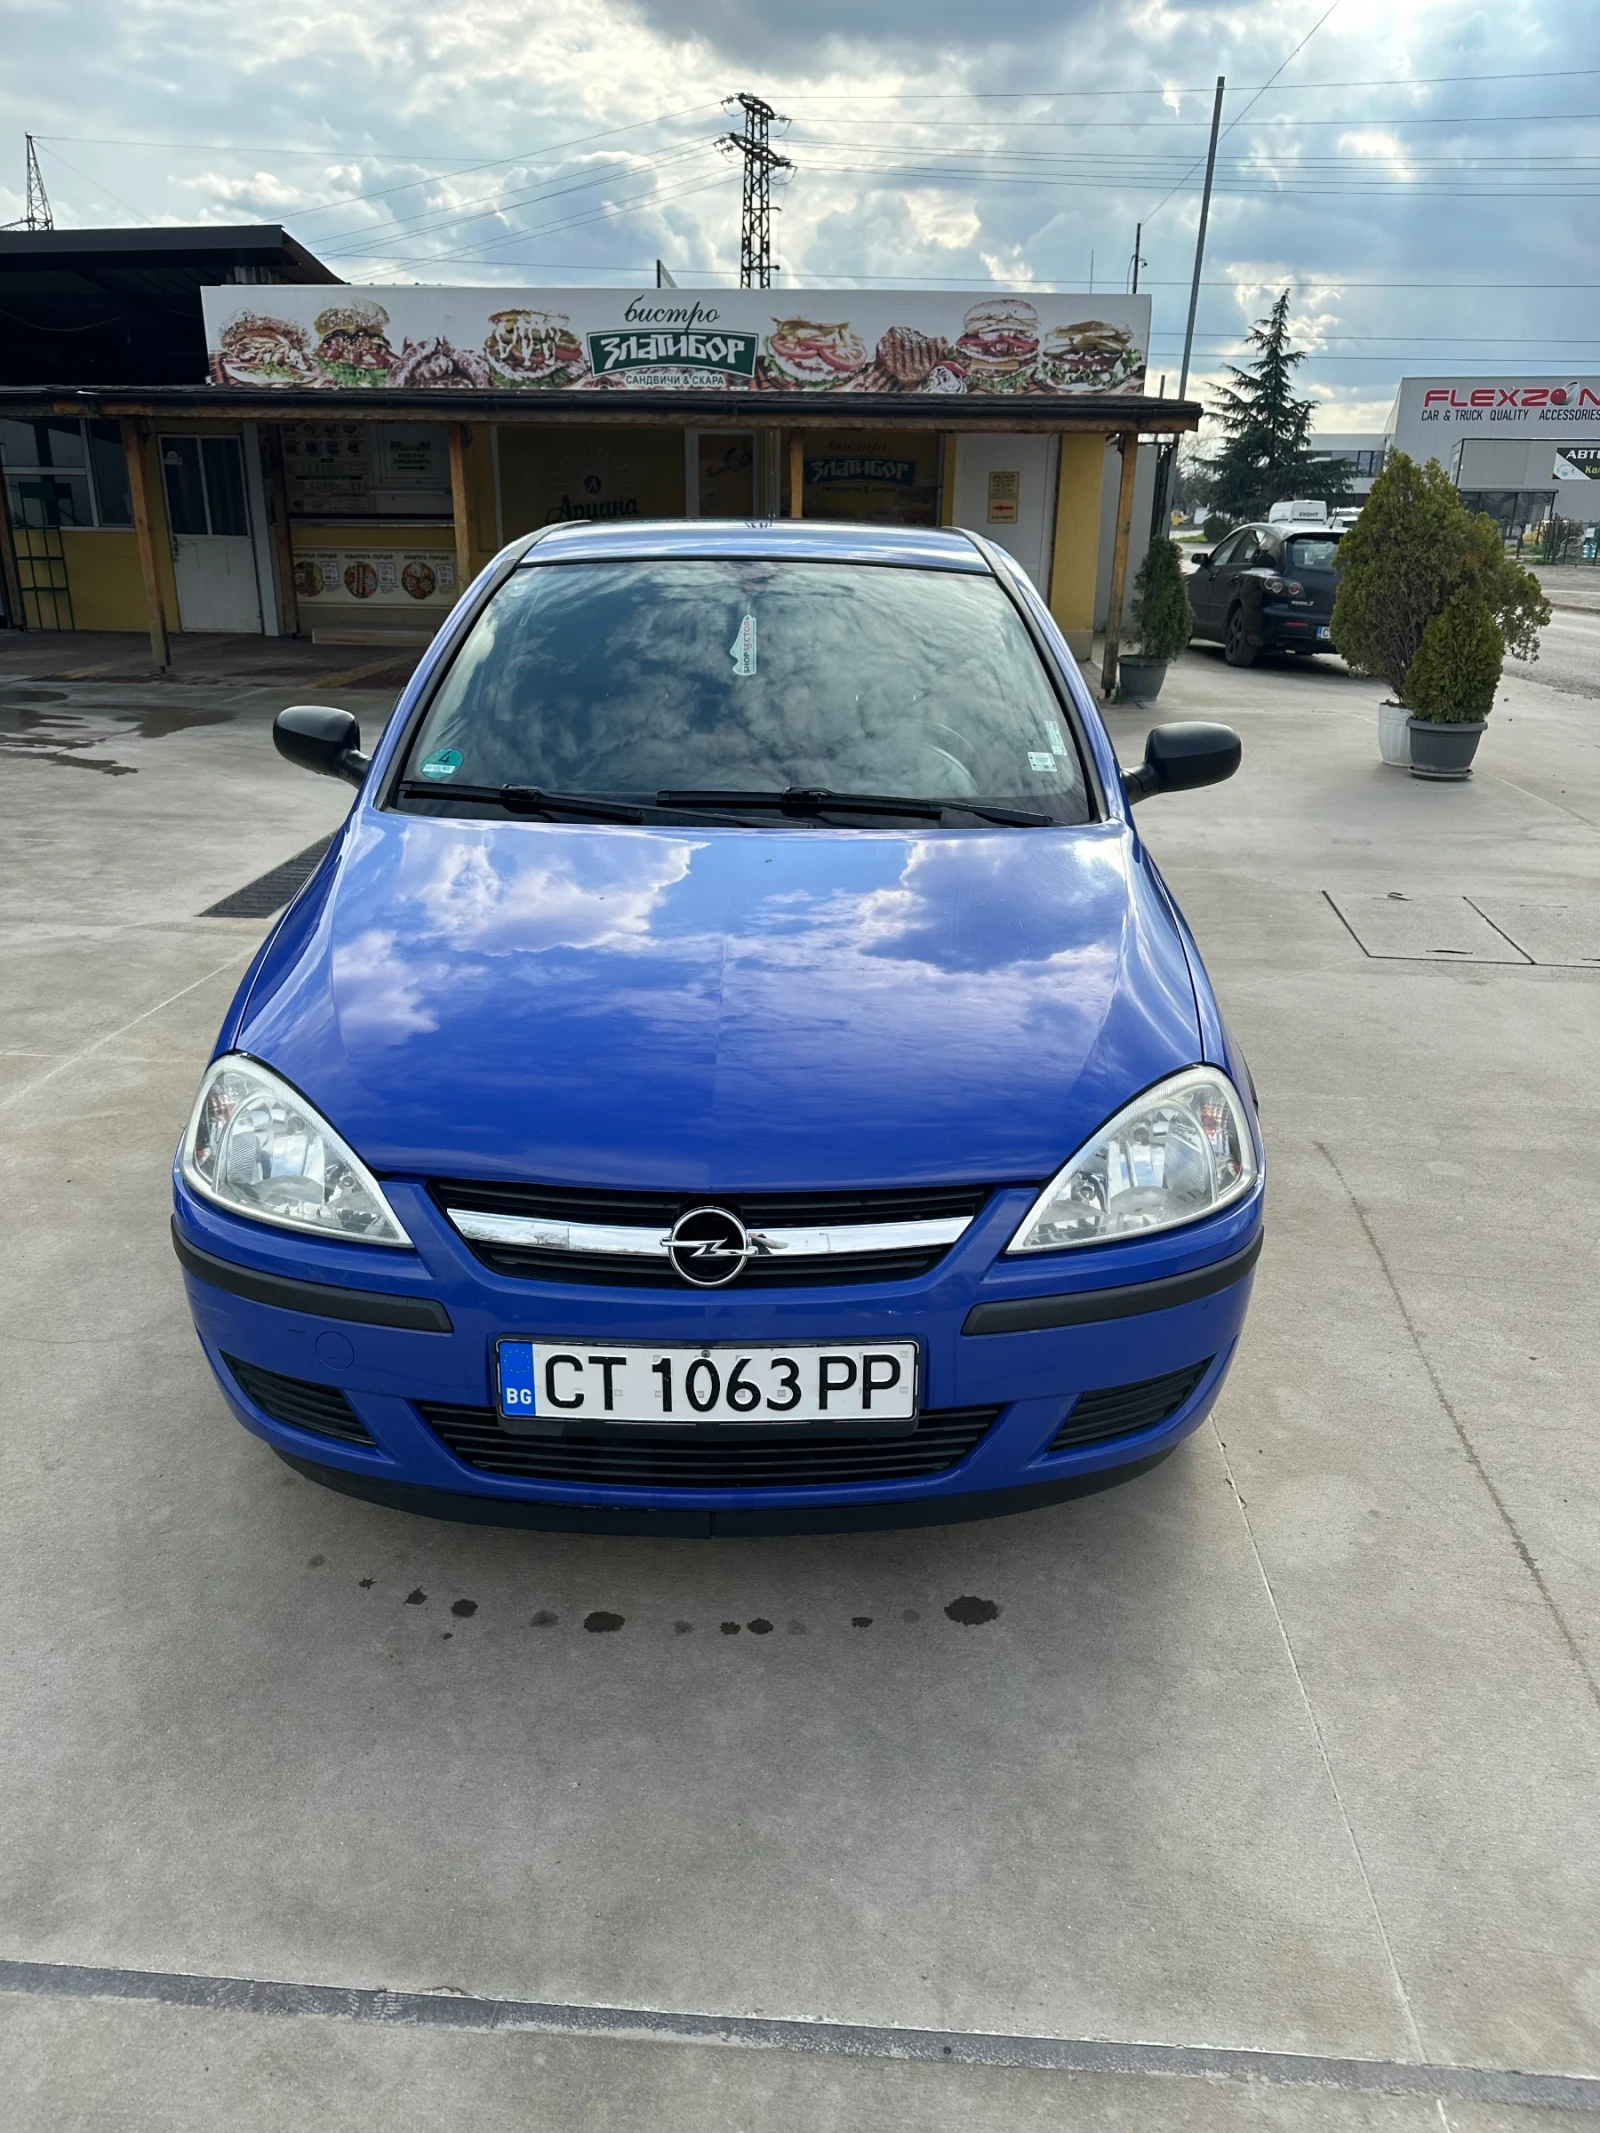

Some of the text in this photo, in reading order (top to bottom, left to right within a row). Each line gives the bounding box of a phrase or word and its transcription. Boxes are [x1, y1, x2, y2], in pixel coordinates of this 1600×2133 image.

[624, 294, 720, 332] бистро
[626, 375, 724, 386] САНДВИЧИ & СКАРА
[1421, 409, 1600, 421] CAR & TRUCK QUALITY ACCESSORIES
[545, 1354, 901, 1412] CT 1063 PP
[507, 1388, 532, 1405] BG
